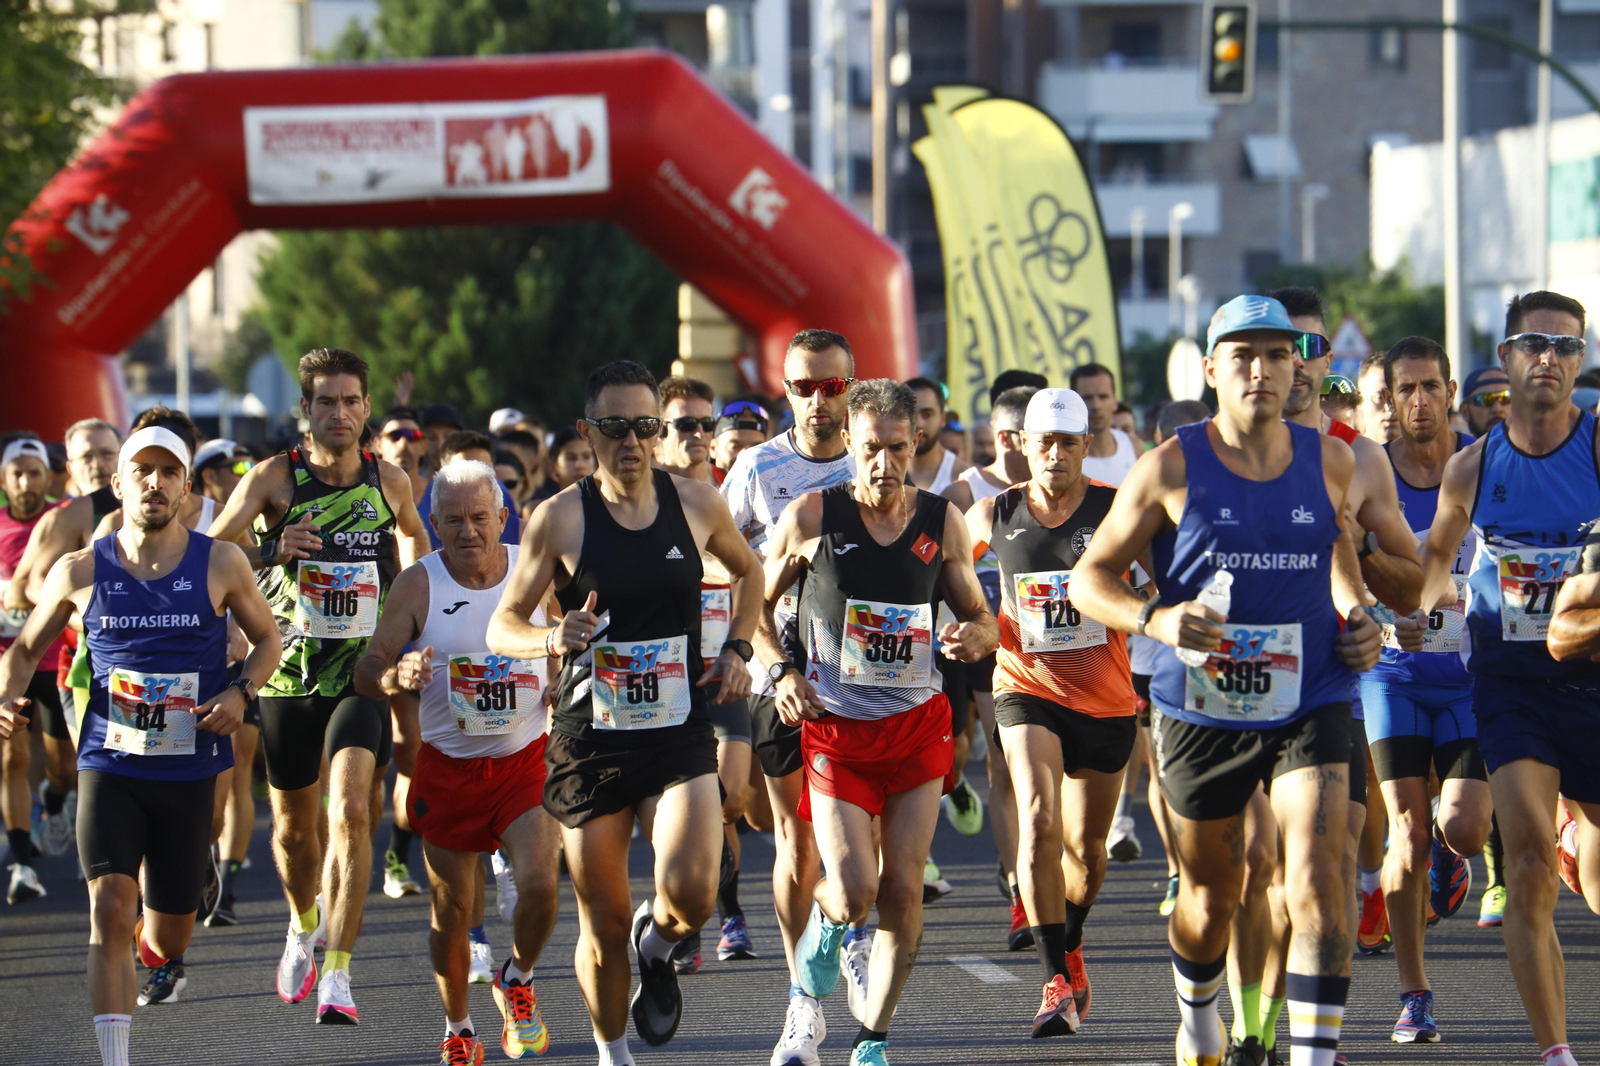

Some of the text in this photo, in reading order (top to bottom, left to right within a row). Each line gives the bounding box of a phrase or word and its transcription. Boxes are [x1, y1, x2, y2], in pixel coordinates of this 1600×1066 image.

[333, 531, 381, 549] eyas
[347, 548, 378, 556] TRAIL
[1203, 552, 1318, 570] TROTASIERRA
[322, 590, 359, 617] 106
[1042, 600, 1081, 629] 126
[99, 614, 200, 629] TROTASIERRA
[865, 633, 913, 664] 394
[626, 672, 659, 705] 59
[1216, 660, 1272, 695] 395
[476, 681, 517, 711] 391
[136, 702, 167, 732] 84
